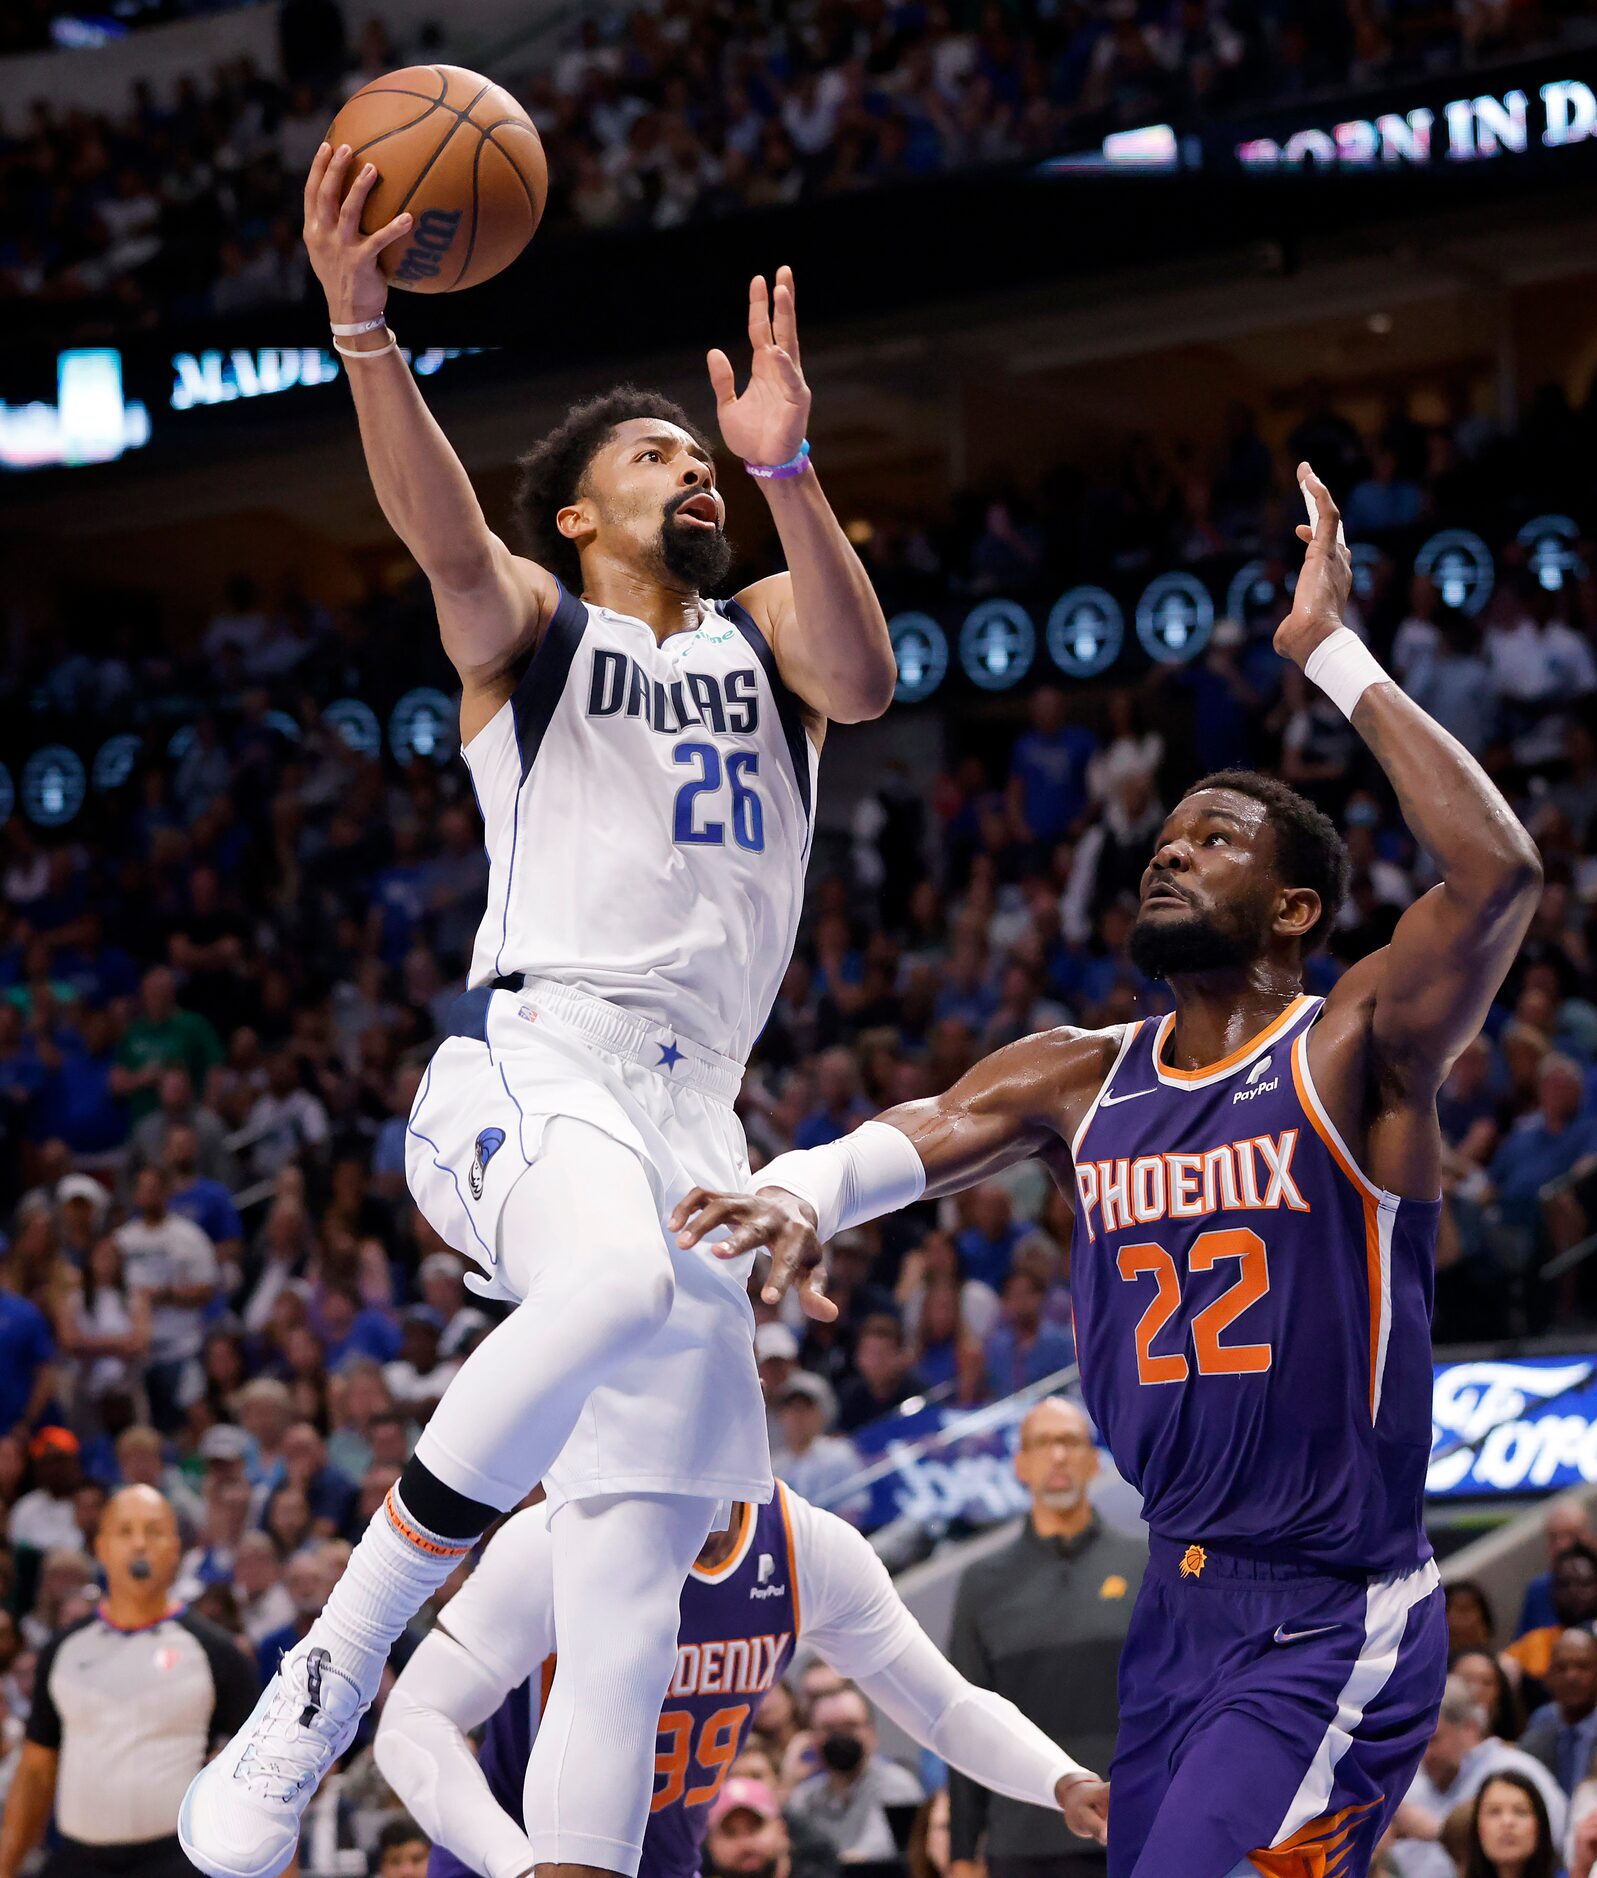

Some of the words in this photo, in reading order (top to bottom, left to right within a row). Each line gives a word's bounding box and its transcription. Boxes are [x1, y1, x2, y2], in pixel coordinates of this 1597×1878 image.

[1444, 89, 1529, 158] IN
[1539, 79, 1597, 148] D
[585, 647, 760, 737] DALLAS
[672, 741, 766, 855] 26
[1232, 1077, 1279, 1105] PayPal
[1074, 1127, 1311, 1245] PHOENIX
[1115, 1227, 1272, 1386] 22
[1424, 1361, 1597, 1493] For
[750, 1584, 786, 1600] PayPal
[665, 1631, 791, 1698] OENIX
